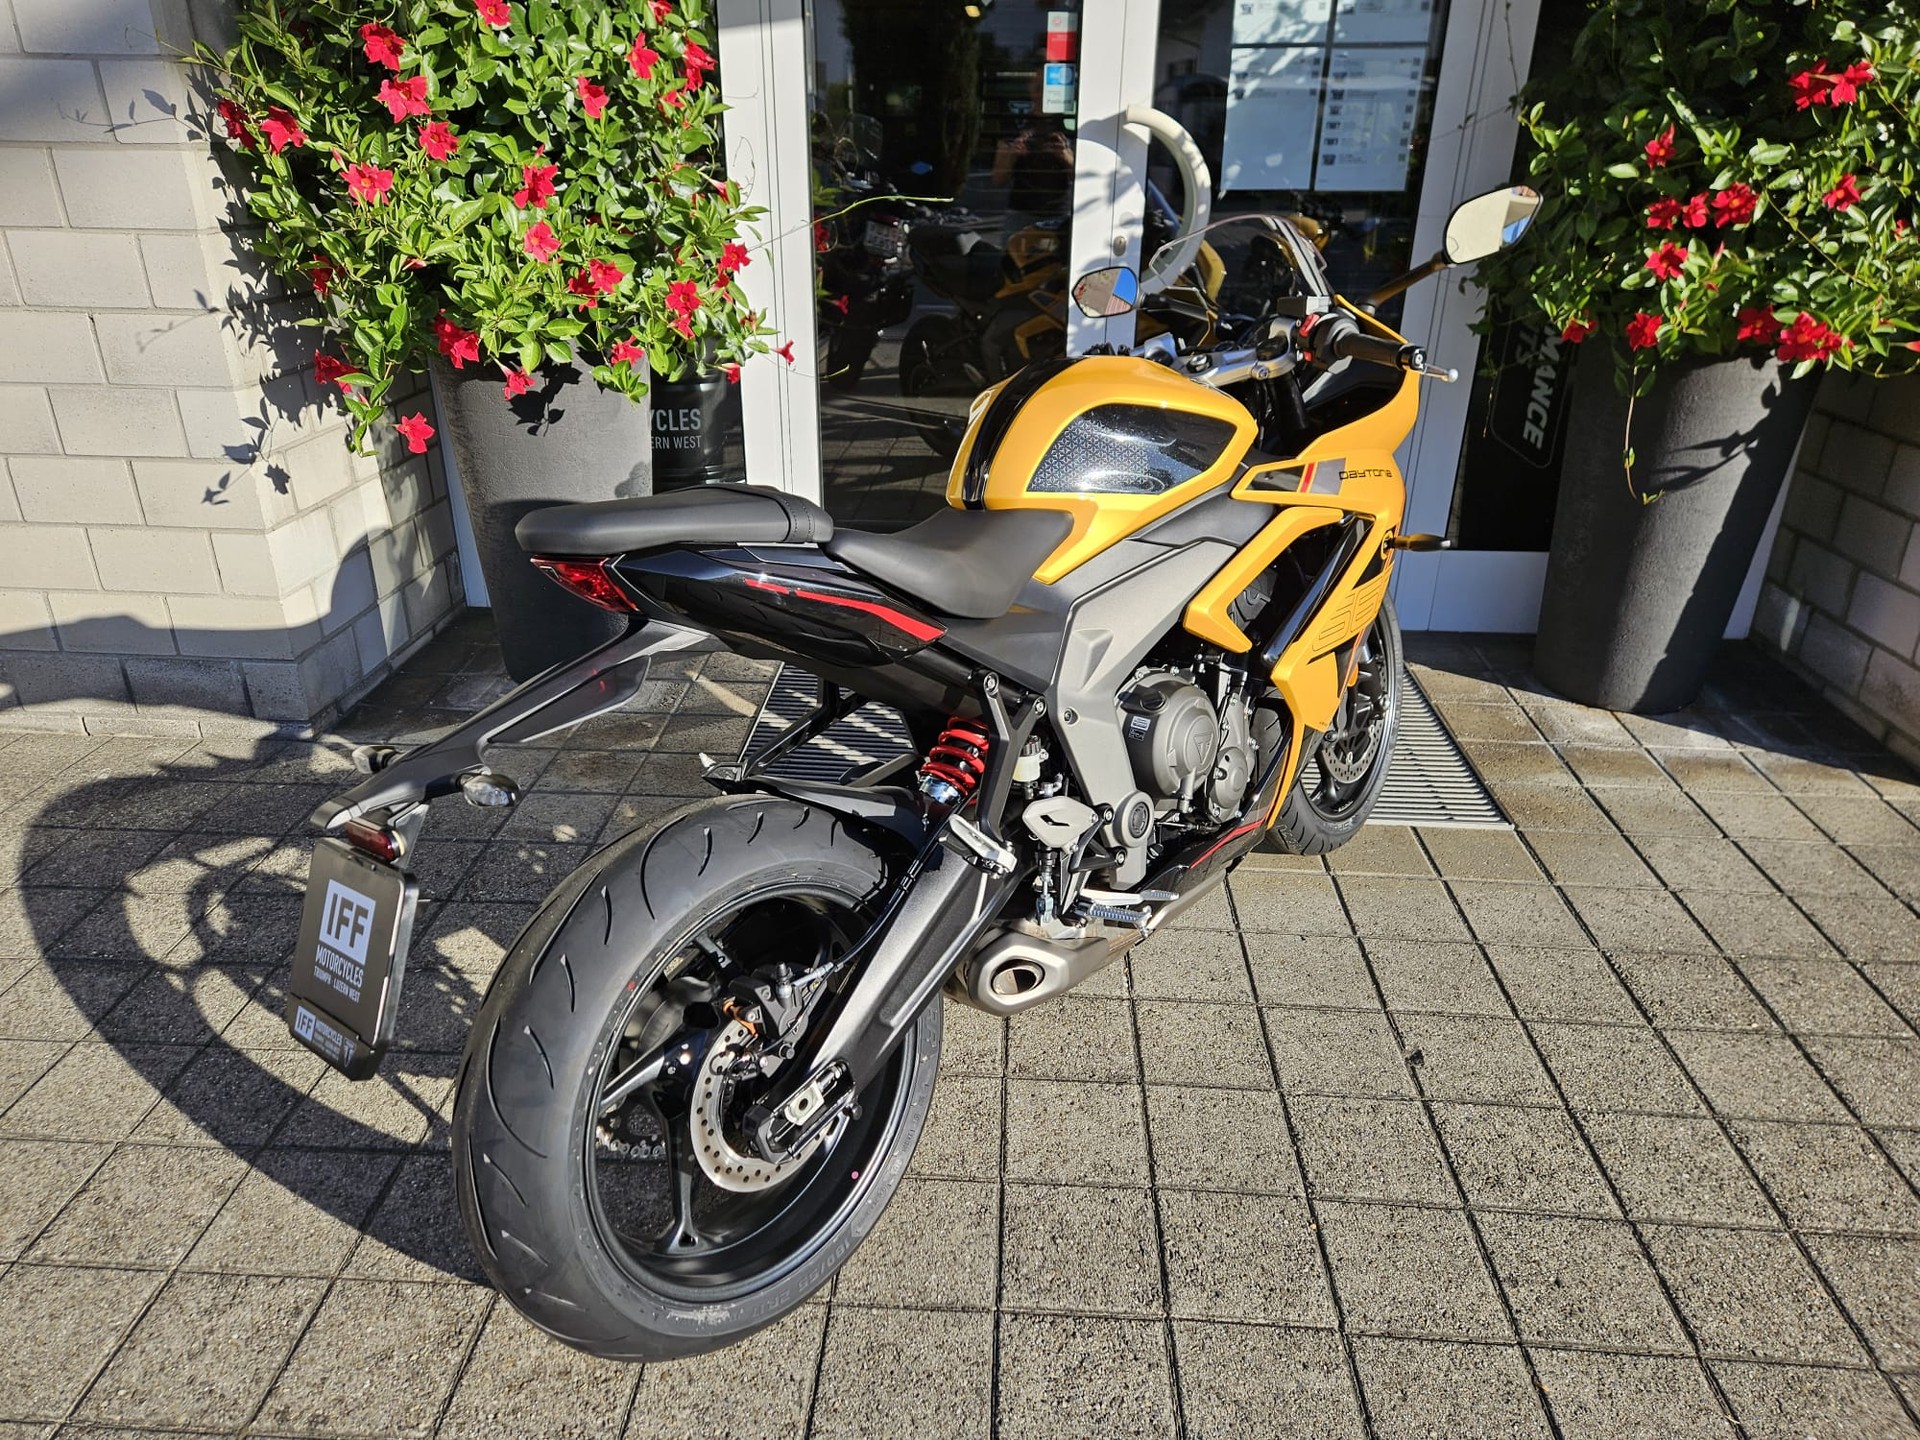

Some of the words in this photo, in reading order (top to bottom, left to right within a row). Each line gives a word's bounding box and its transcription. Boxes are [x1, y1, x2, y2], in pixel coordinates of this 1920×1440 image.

[1523, 325, 1564, 449] MANCE
[673, 435, 702, 449] WEST
[326, 892, 370, 949] IFF
[314, 944, 364, 988] MOTORCYCLES
[297, 1011, 313, 1035] IFF
